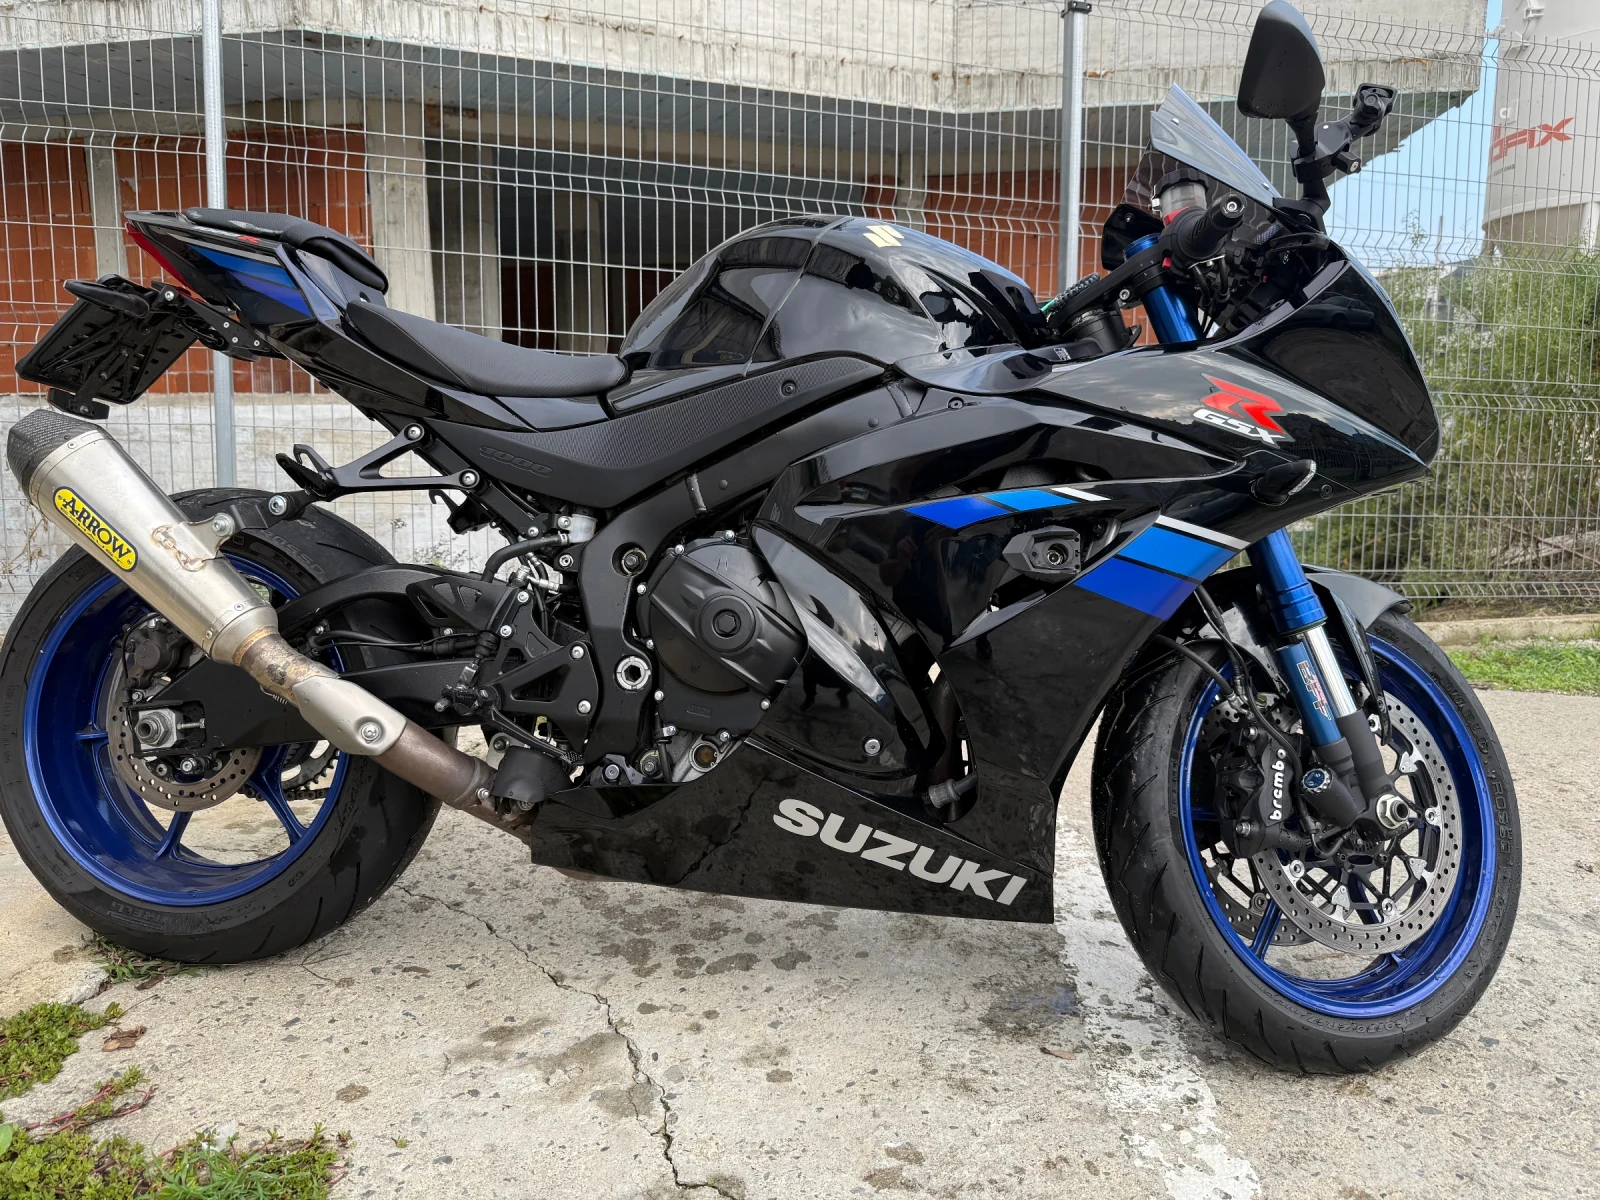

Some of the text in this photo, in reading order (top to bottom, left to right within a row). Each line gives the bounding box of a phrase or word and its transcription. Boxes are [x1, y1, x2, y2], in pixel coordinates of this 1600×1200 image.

[1193, 408, 1286, 445] GSX
[1202, 374, 1288, 436] R
[63, 496, 133, 560] ARROW
[1269, 748, 1287, 821] brembo
[772, 798, 1028, 906] SUZUKI
